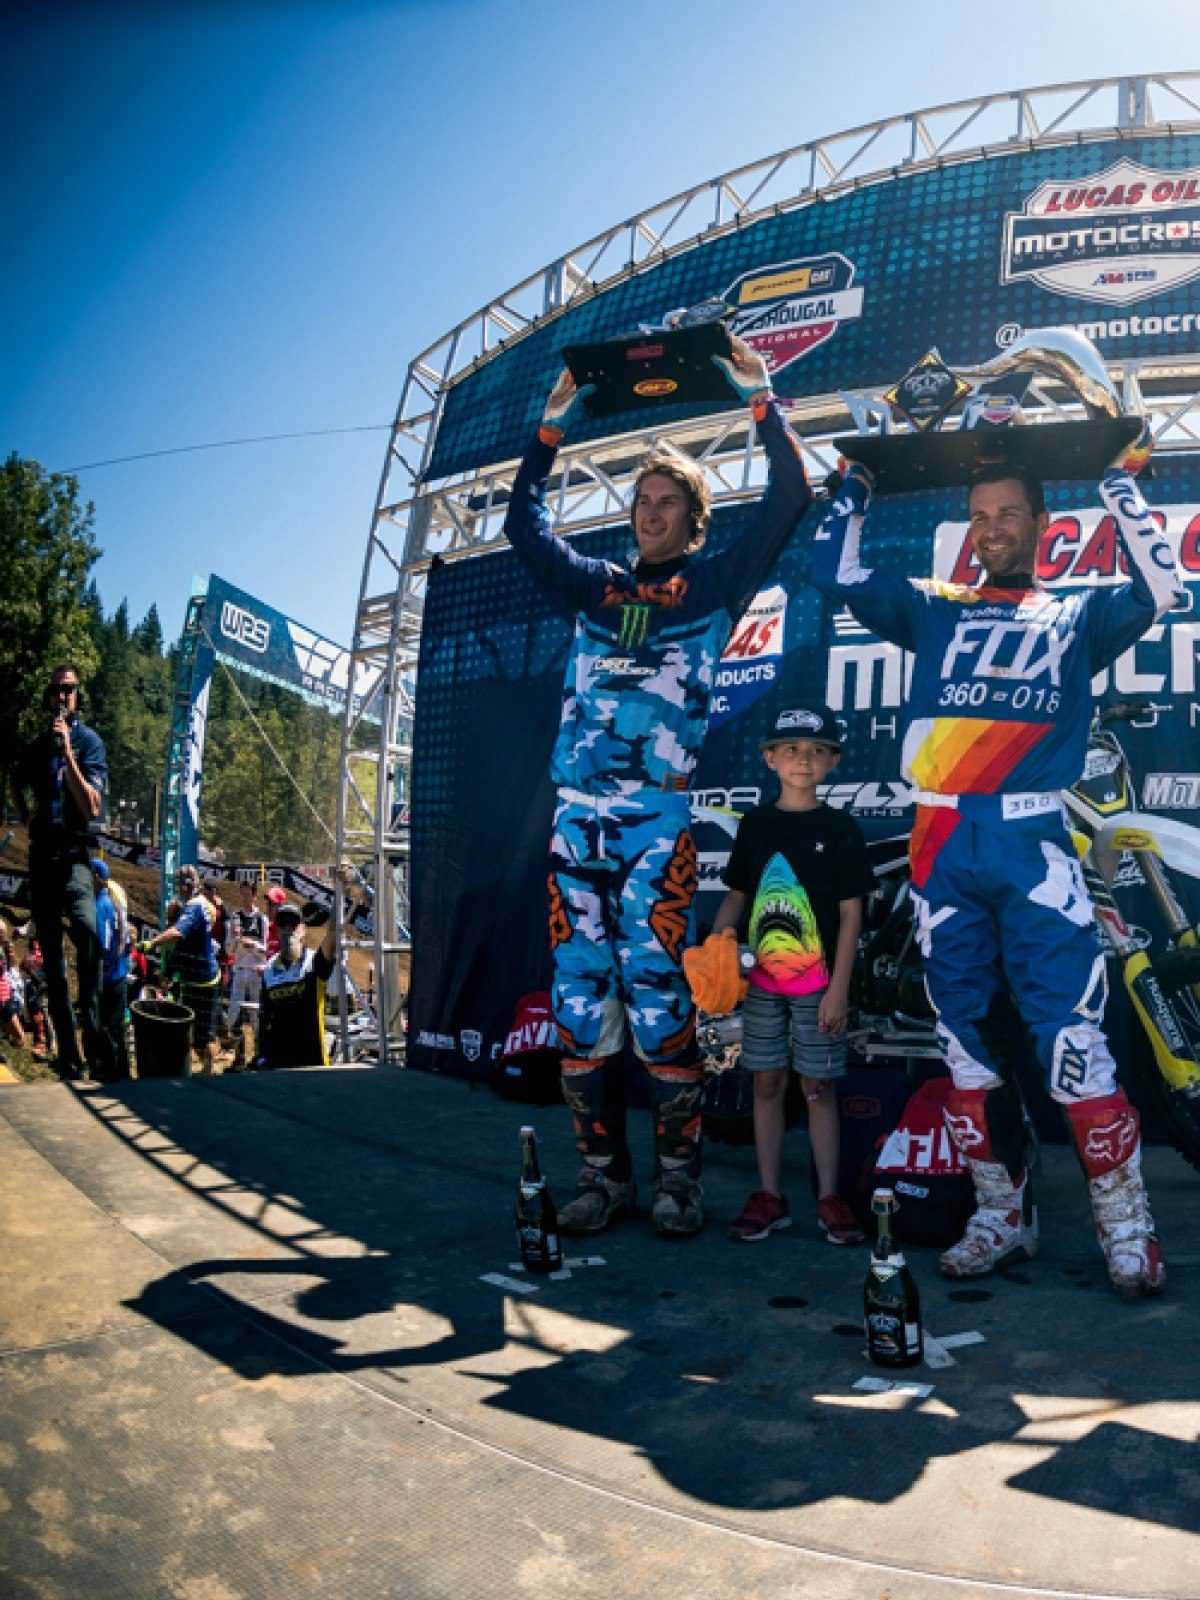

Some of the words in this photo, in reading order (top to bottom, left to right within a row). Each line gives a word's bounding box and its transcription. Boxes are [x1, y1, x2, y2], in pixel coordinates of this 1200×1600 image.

[1044, 181, 1146, 212] LUCAS
[1151, 179, 1200, 201] OIL
[754, 299, 836, 329] HOUGAL
[949, 511, 1166, 587] LCA
[941, 620, 1076, 687] FOX
[715, 663, 776, 687] DUCTS
[938, 682, 988, 707] 360
